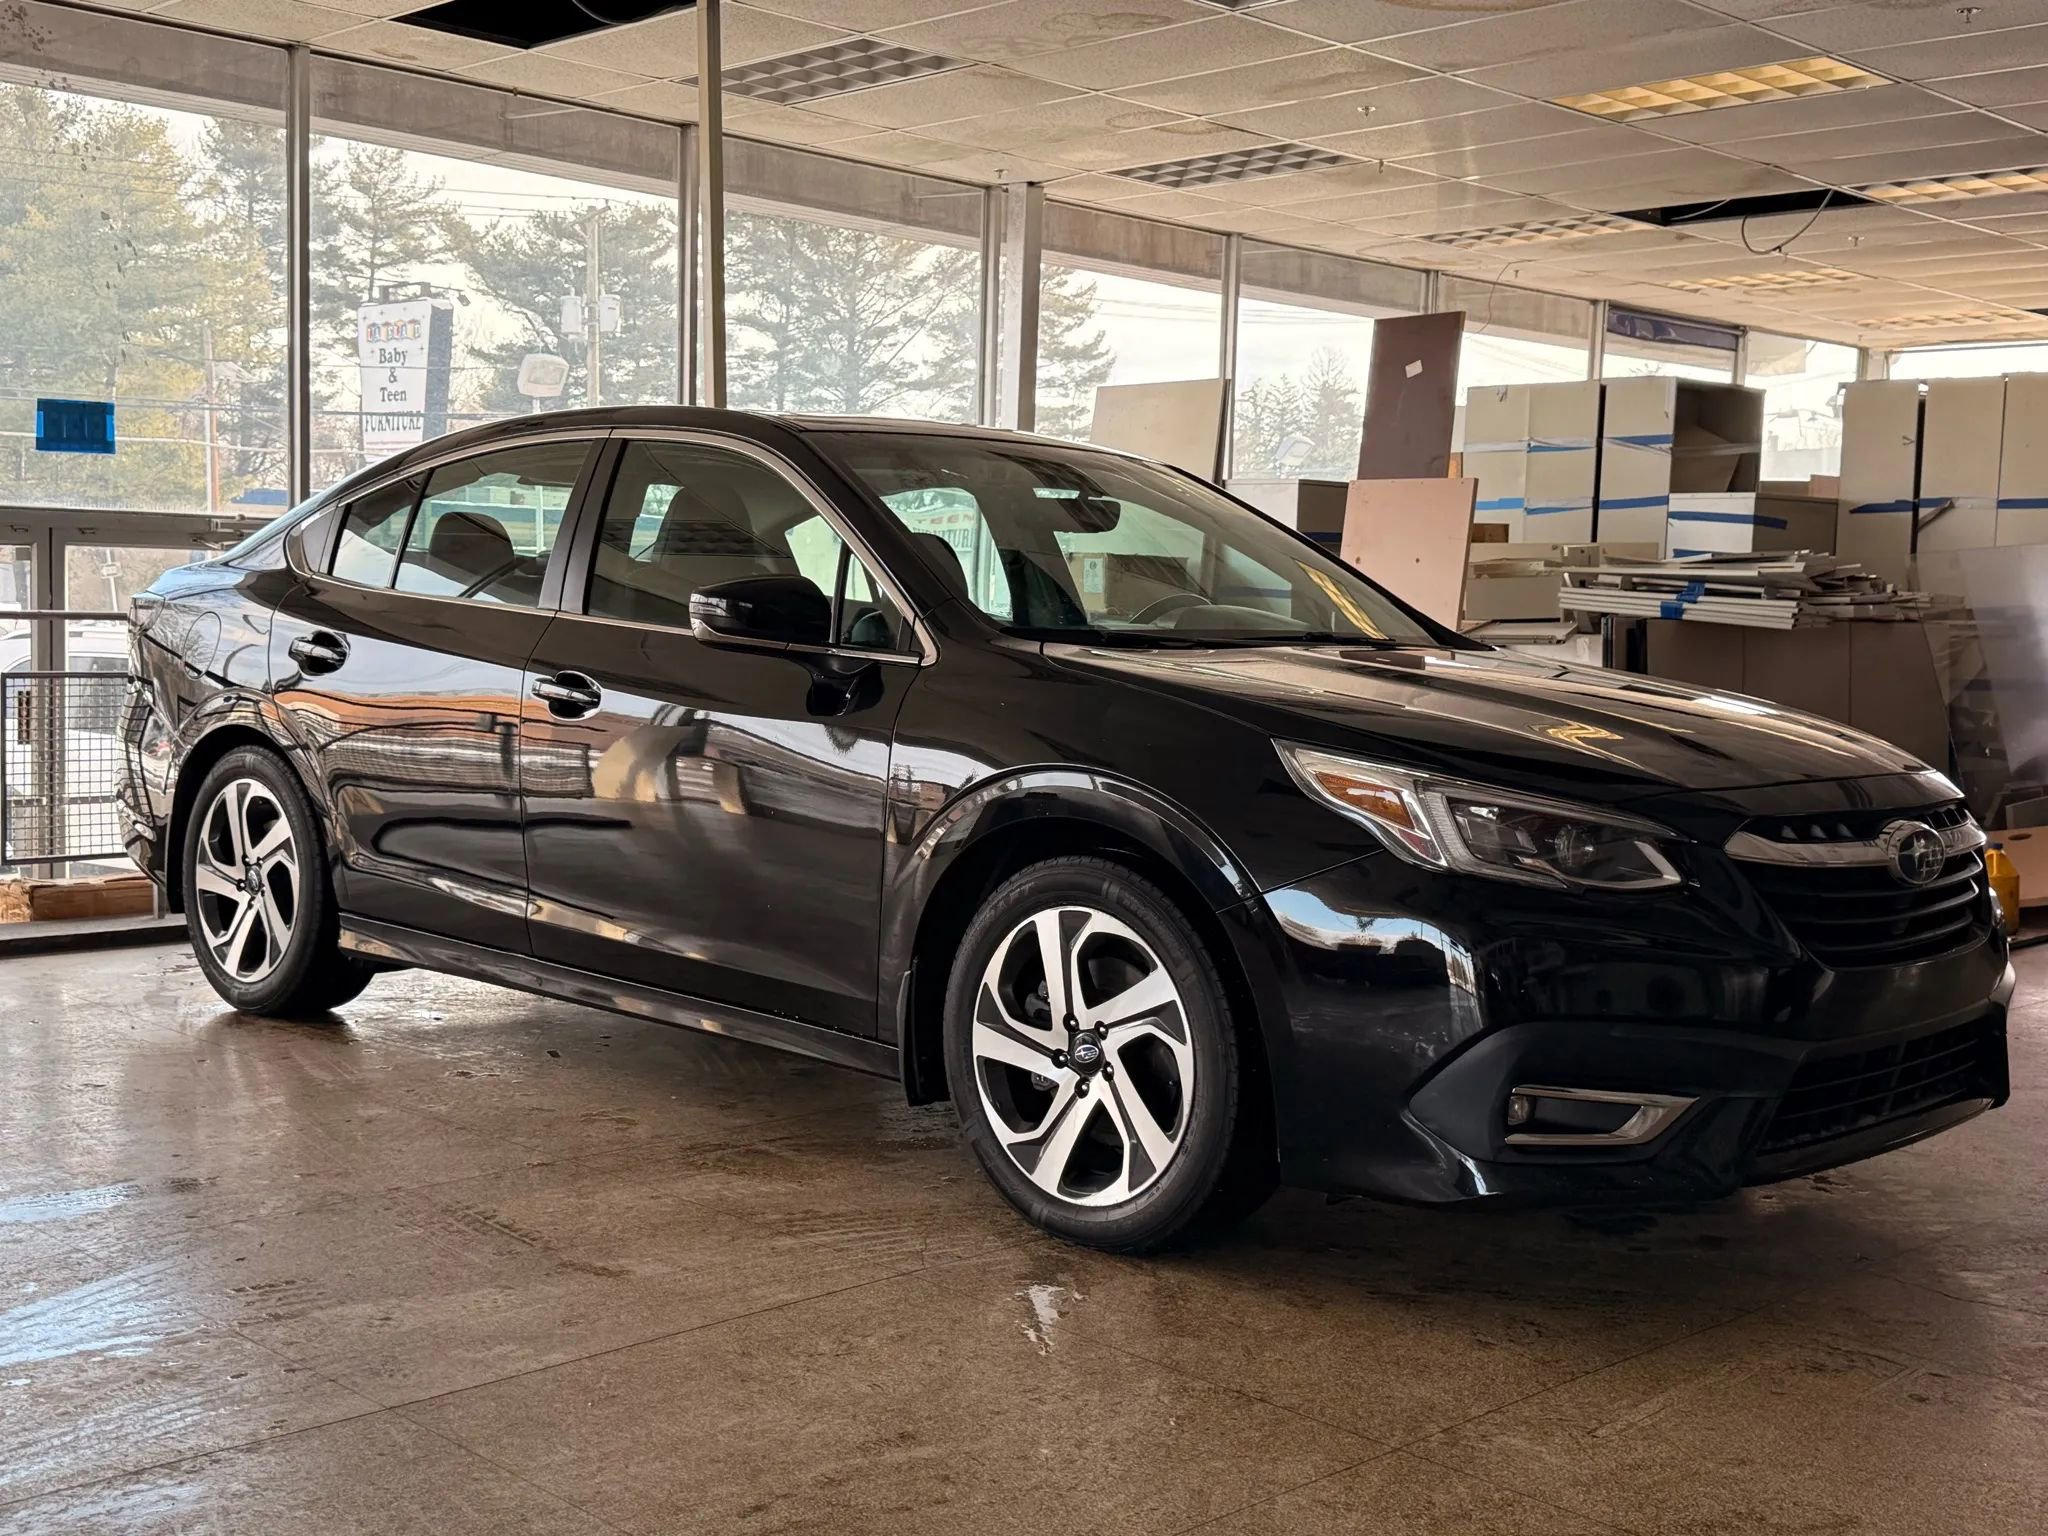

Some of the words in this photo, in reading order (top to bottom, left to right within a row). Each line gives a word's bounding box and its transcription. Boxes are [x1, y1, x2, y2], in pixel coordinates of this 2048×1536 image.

[379, 348, 408, 365] Baby
[388, 367, 398, 383] &
[380, 387, 407, 402] Teen
